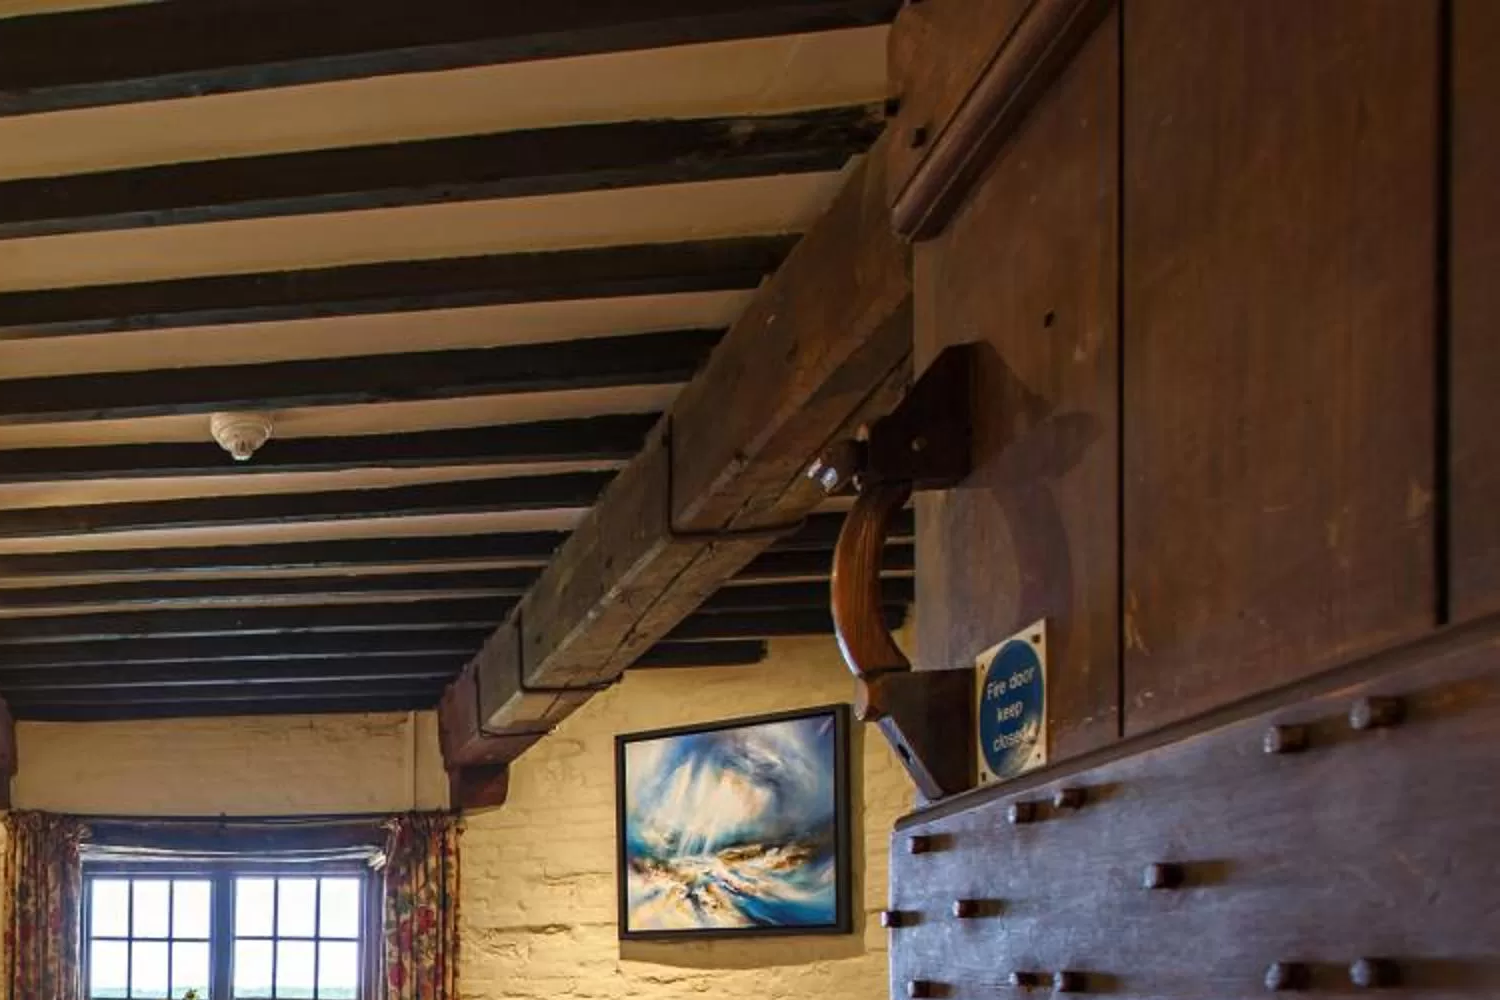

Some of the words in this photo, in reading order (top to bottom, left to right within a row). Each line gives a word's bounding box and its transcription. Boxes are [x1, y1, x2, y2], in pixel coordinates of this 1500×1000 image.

[987, 679, 1007, 700] Fire
[1009, 666, 1035, 690] door
[996, 700, 1024, 722] keep
